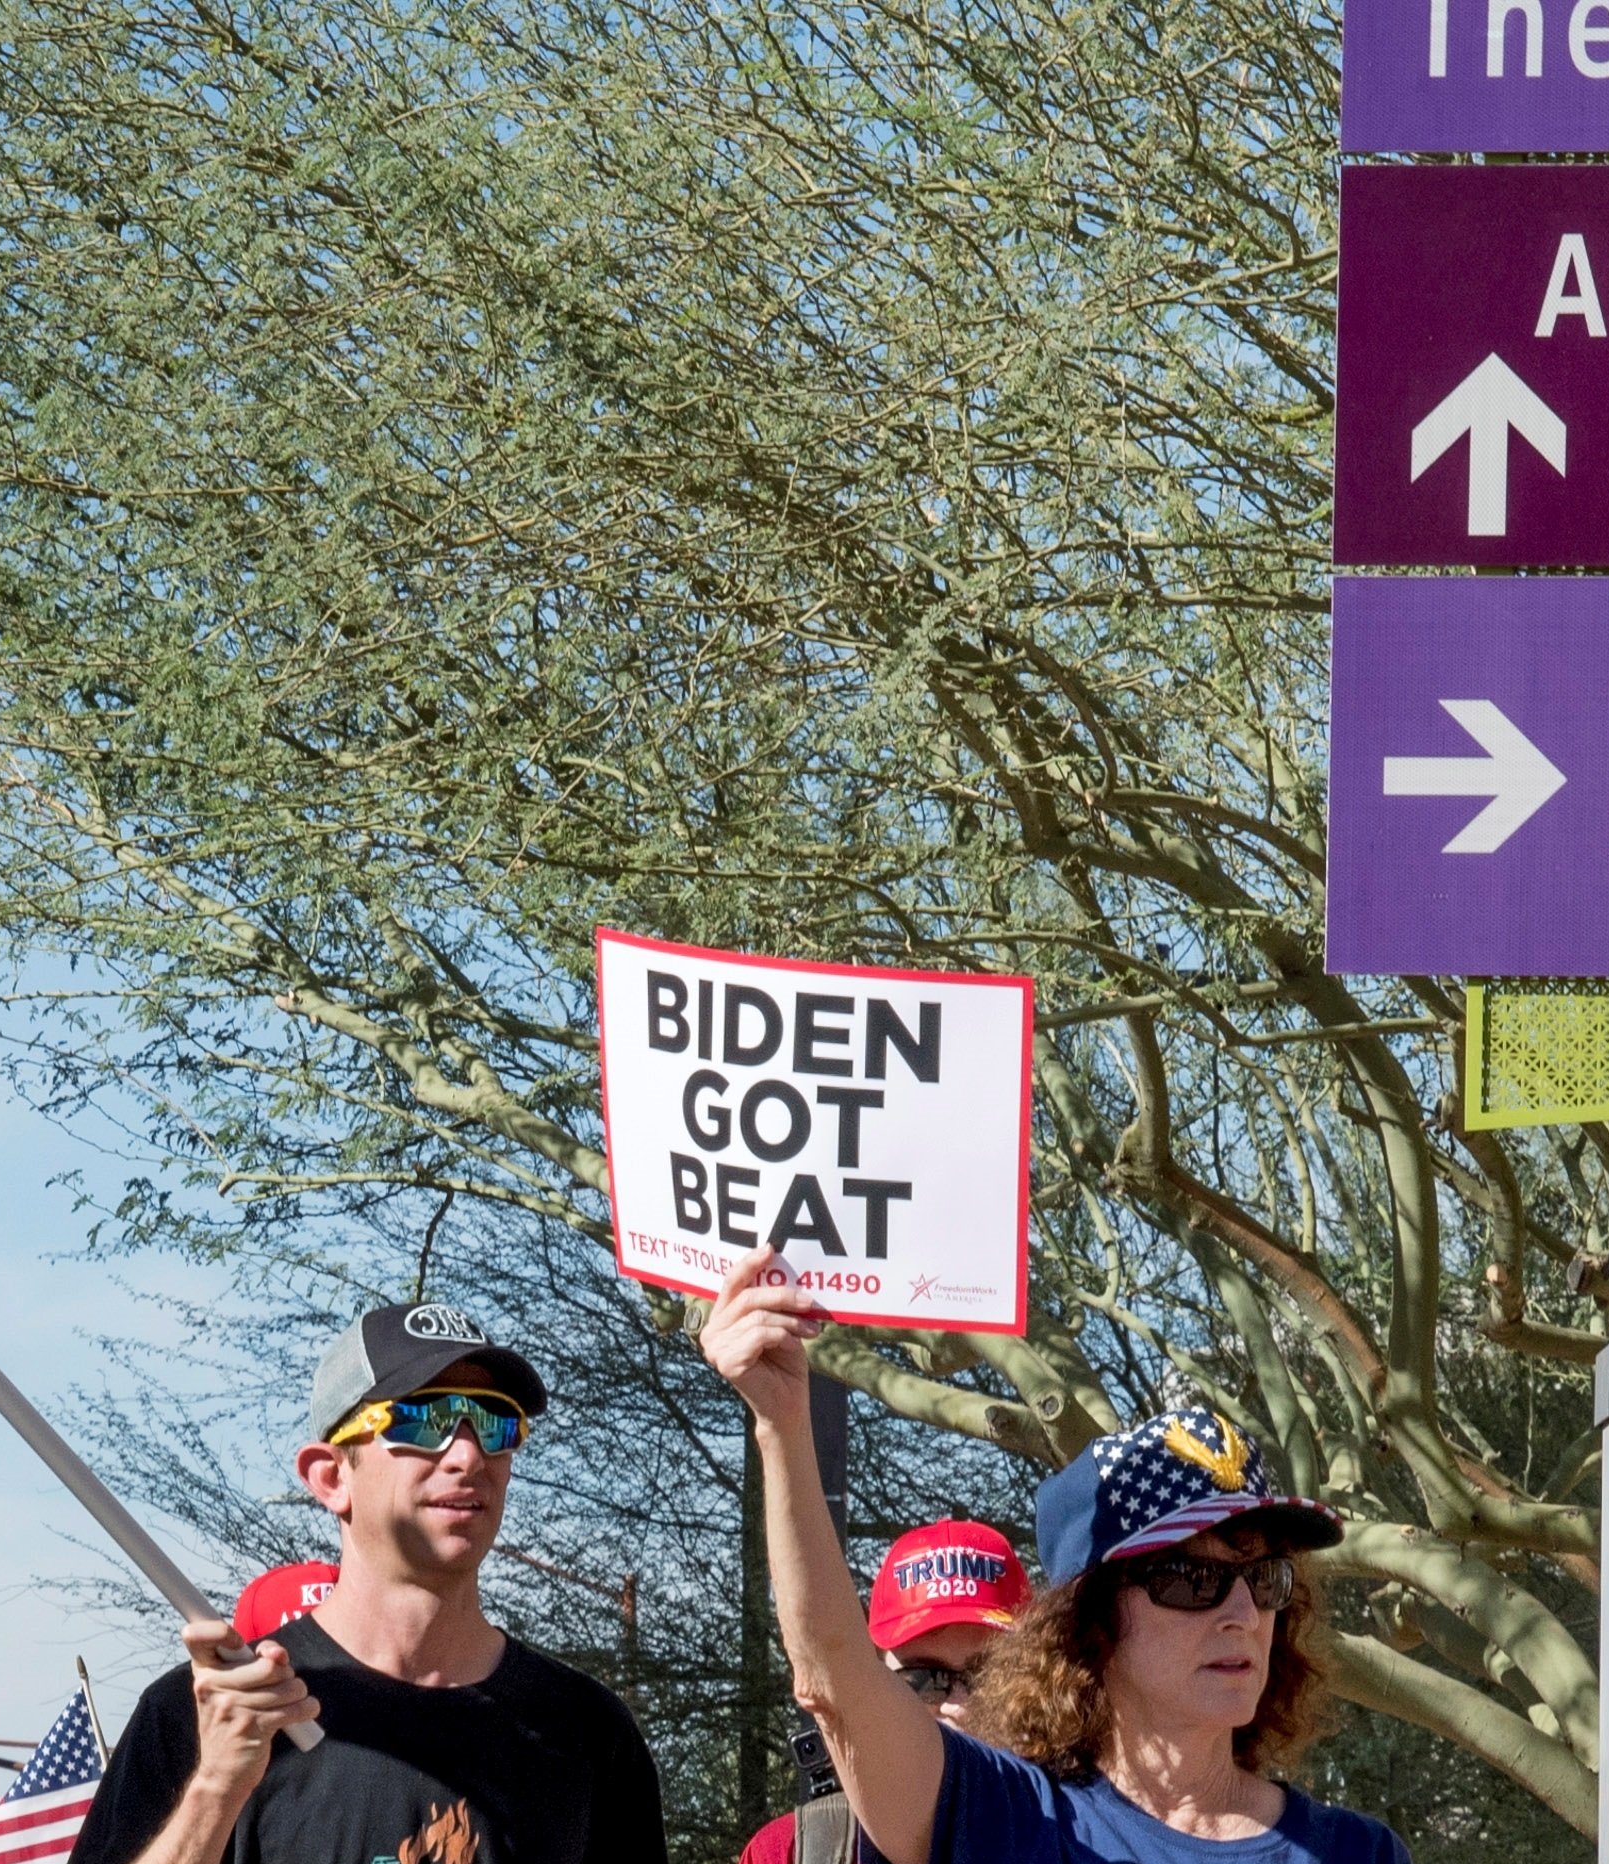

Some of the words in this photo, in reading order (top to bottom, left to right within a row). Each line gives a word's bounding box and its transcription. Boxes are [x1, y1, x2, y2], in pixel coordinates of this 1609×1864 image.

[646, 968, 942, 1084] BIDEN
[682, 1068, 885, 1169] GOT
[669, 1150, 913, 1260] BEAT
[628, 1231, 669, 1259] TEXT
[673, 1242, 734, 1277] “STOLE
[795, 1270, 881, 1295] 41490
[893, 1553, 1007, 1591] TRUMP
[925, 1580, 979, 1600] 2020
